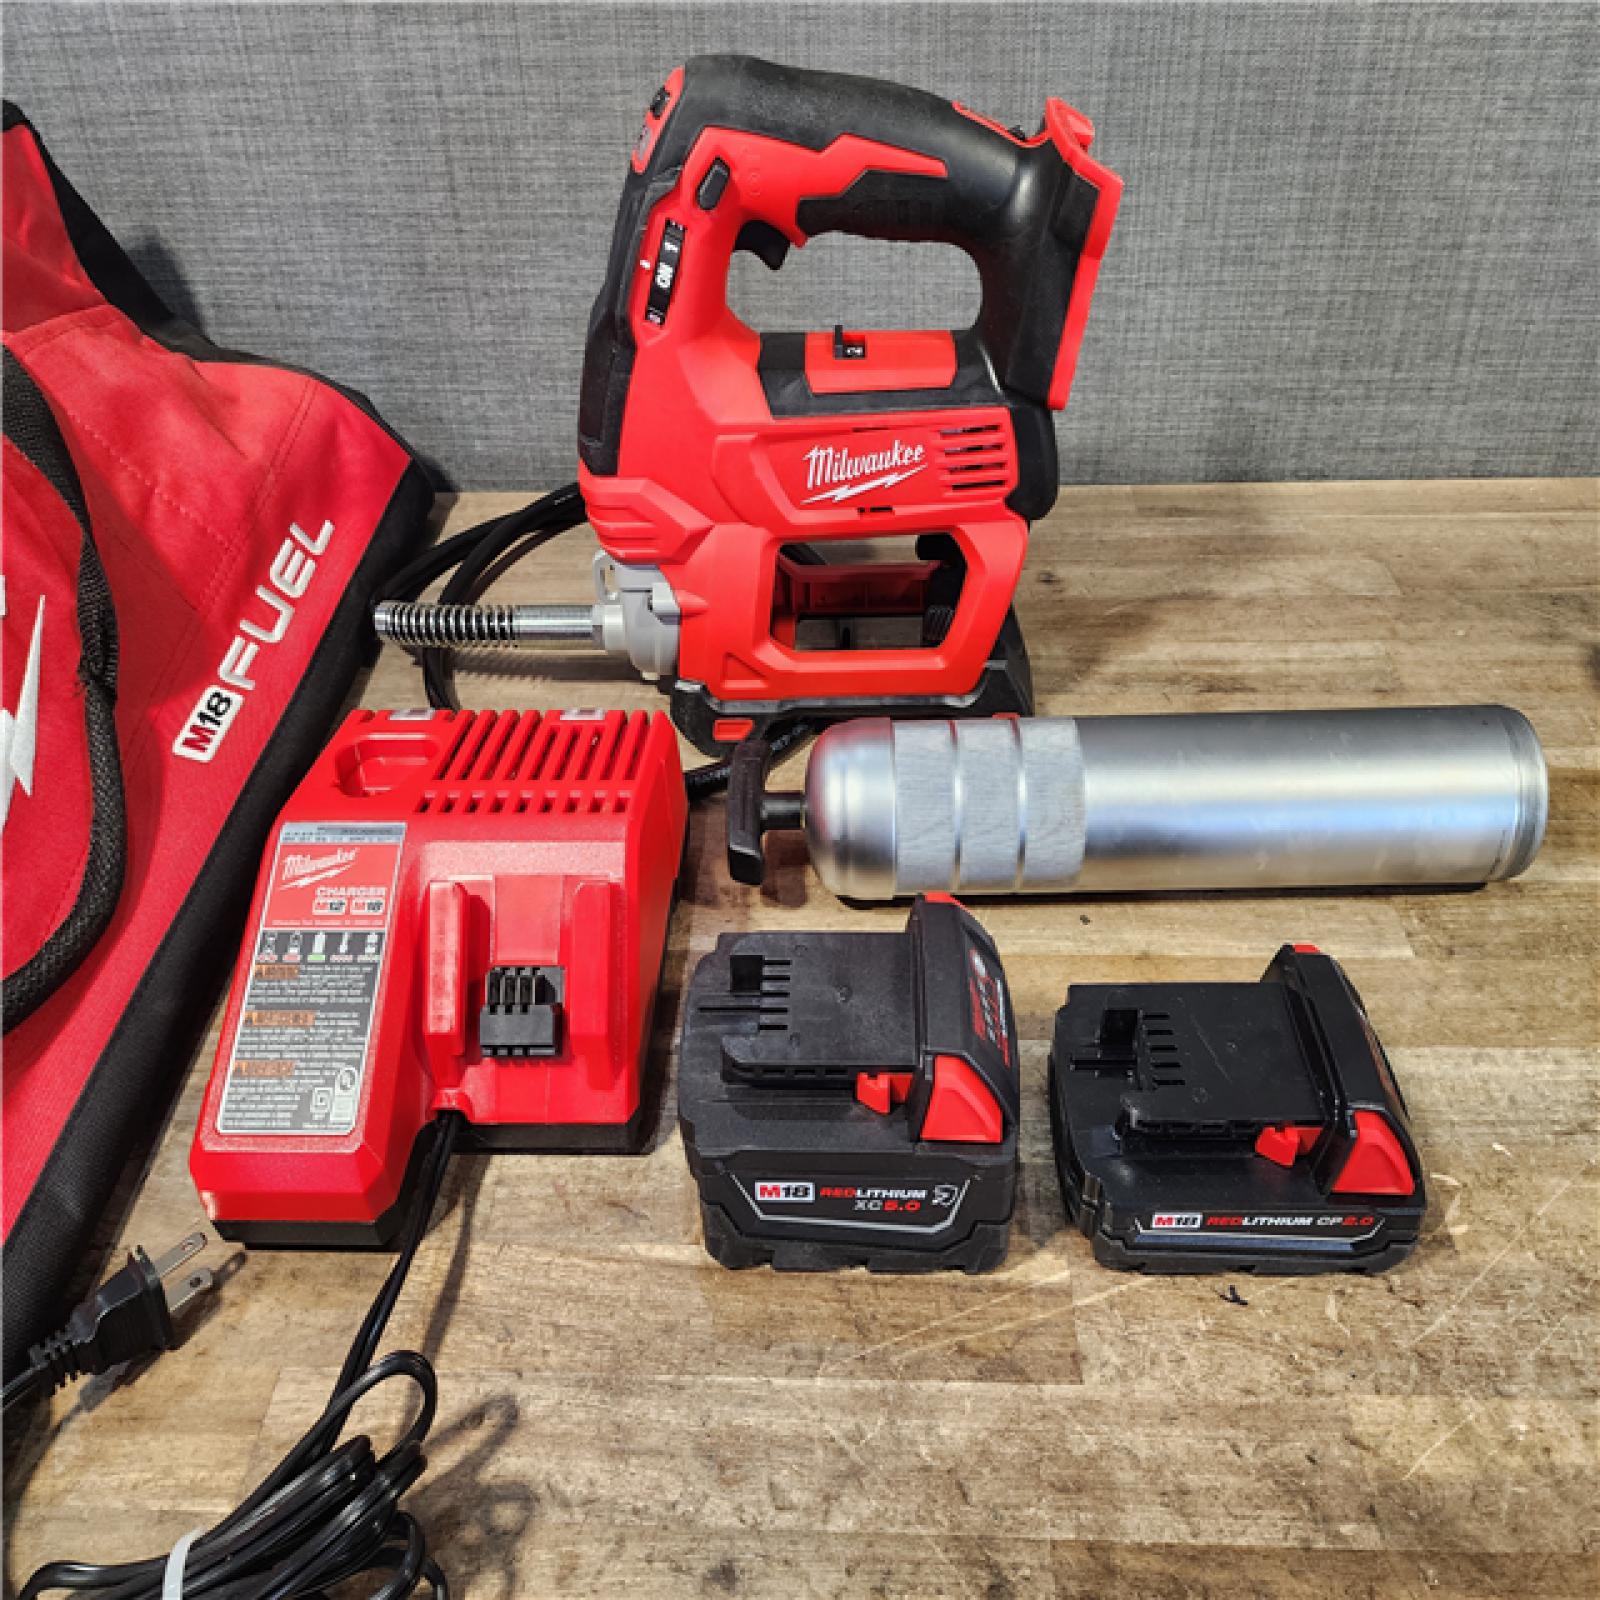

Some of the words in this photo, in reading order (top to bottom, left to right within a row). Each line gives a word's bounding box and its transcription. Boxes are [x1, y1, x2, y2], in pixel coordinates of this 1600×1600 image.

[802, 439, 925, 490] Milwaukee
[179, 689, 234, 754] M18
[217, 519, 335, 690] FUEL
[758, 1184, 811, 1199] M18
[820, 1187, 926, 1199] REDLITHIUM
[1154, 1215, 1200, 1227] M18
[1207, 1216, 1313, 1226] REDLITHIUM
